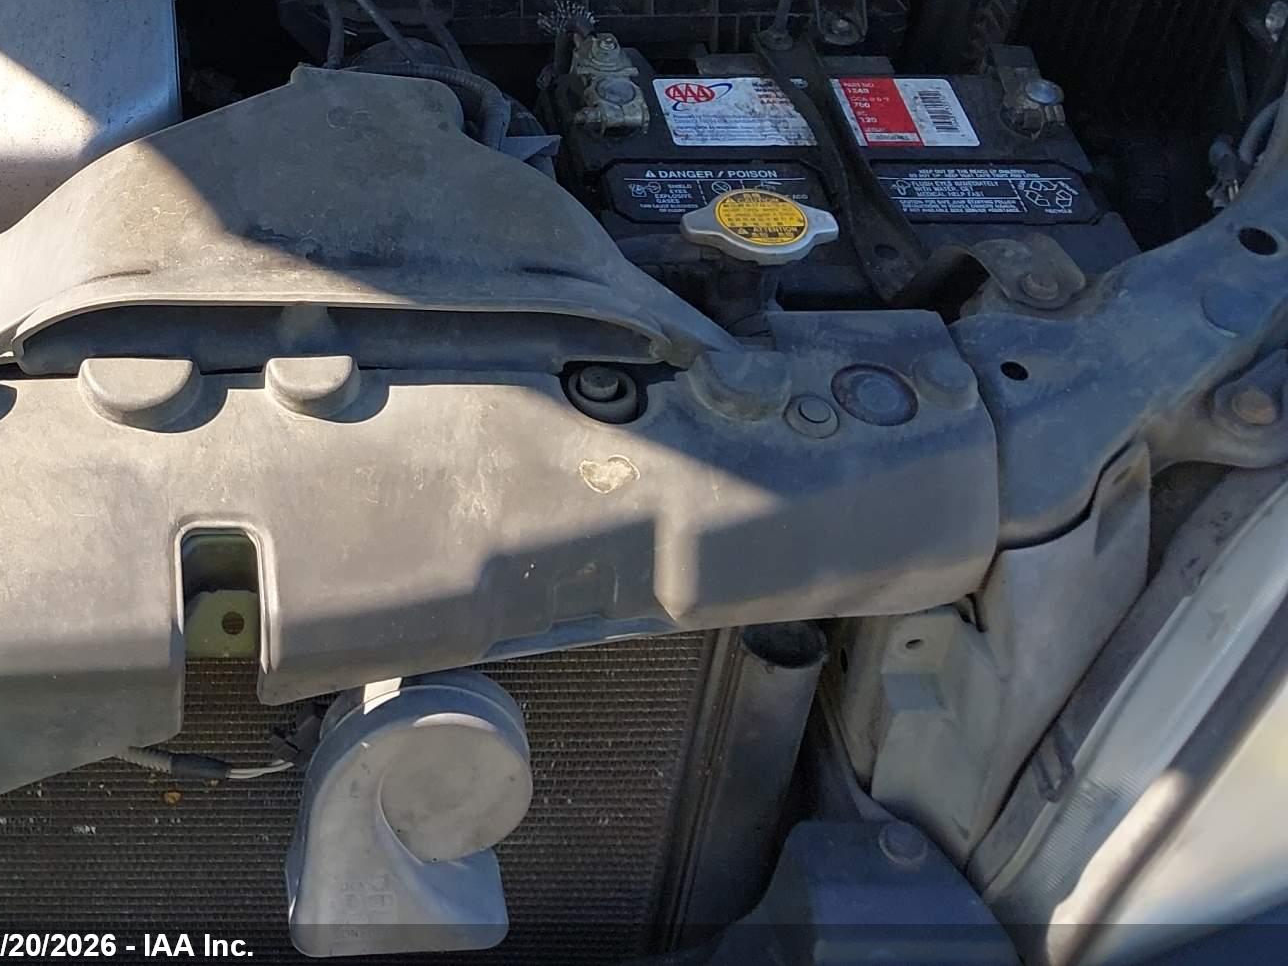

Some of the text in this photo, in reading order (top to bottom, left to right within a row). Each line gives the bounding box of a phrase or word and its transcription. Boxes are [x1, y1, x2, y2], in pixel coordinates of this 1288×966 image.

[670, 85, 714, 102] AAA
[658, 170, 713, 179] DANGER
[727, 170, 778, 179] POISON
